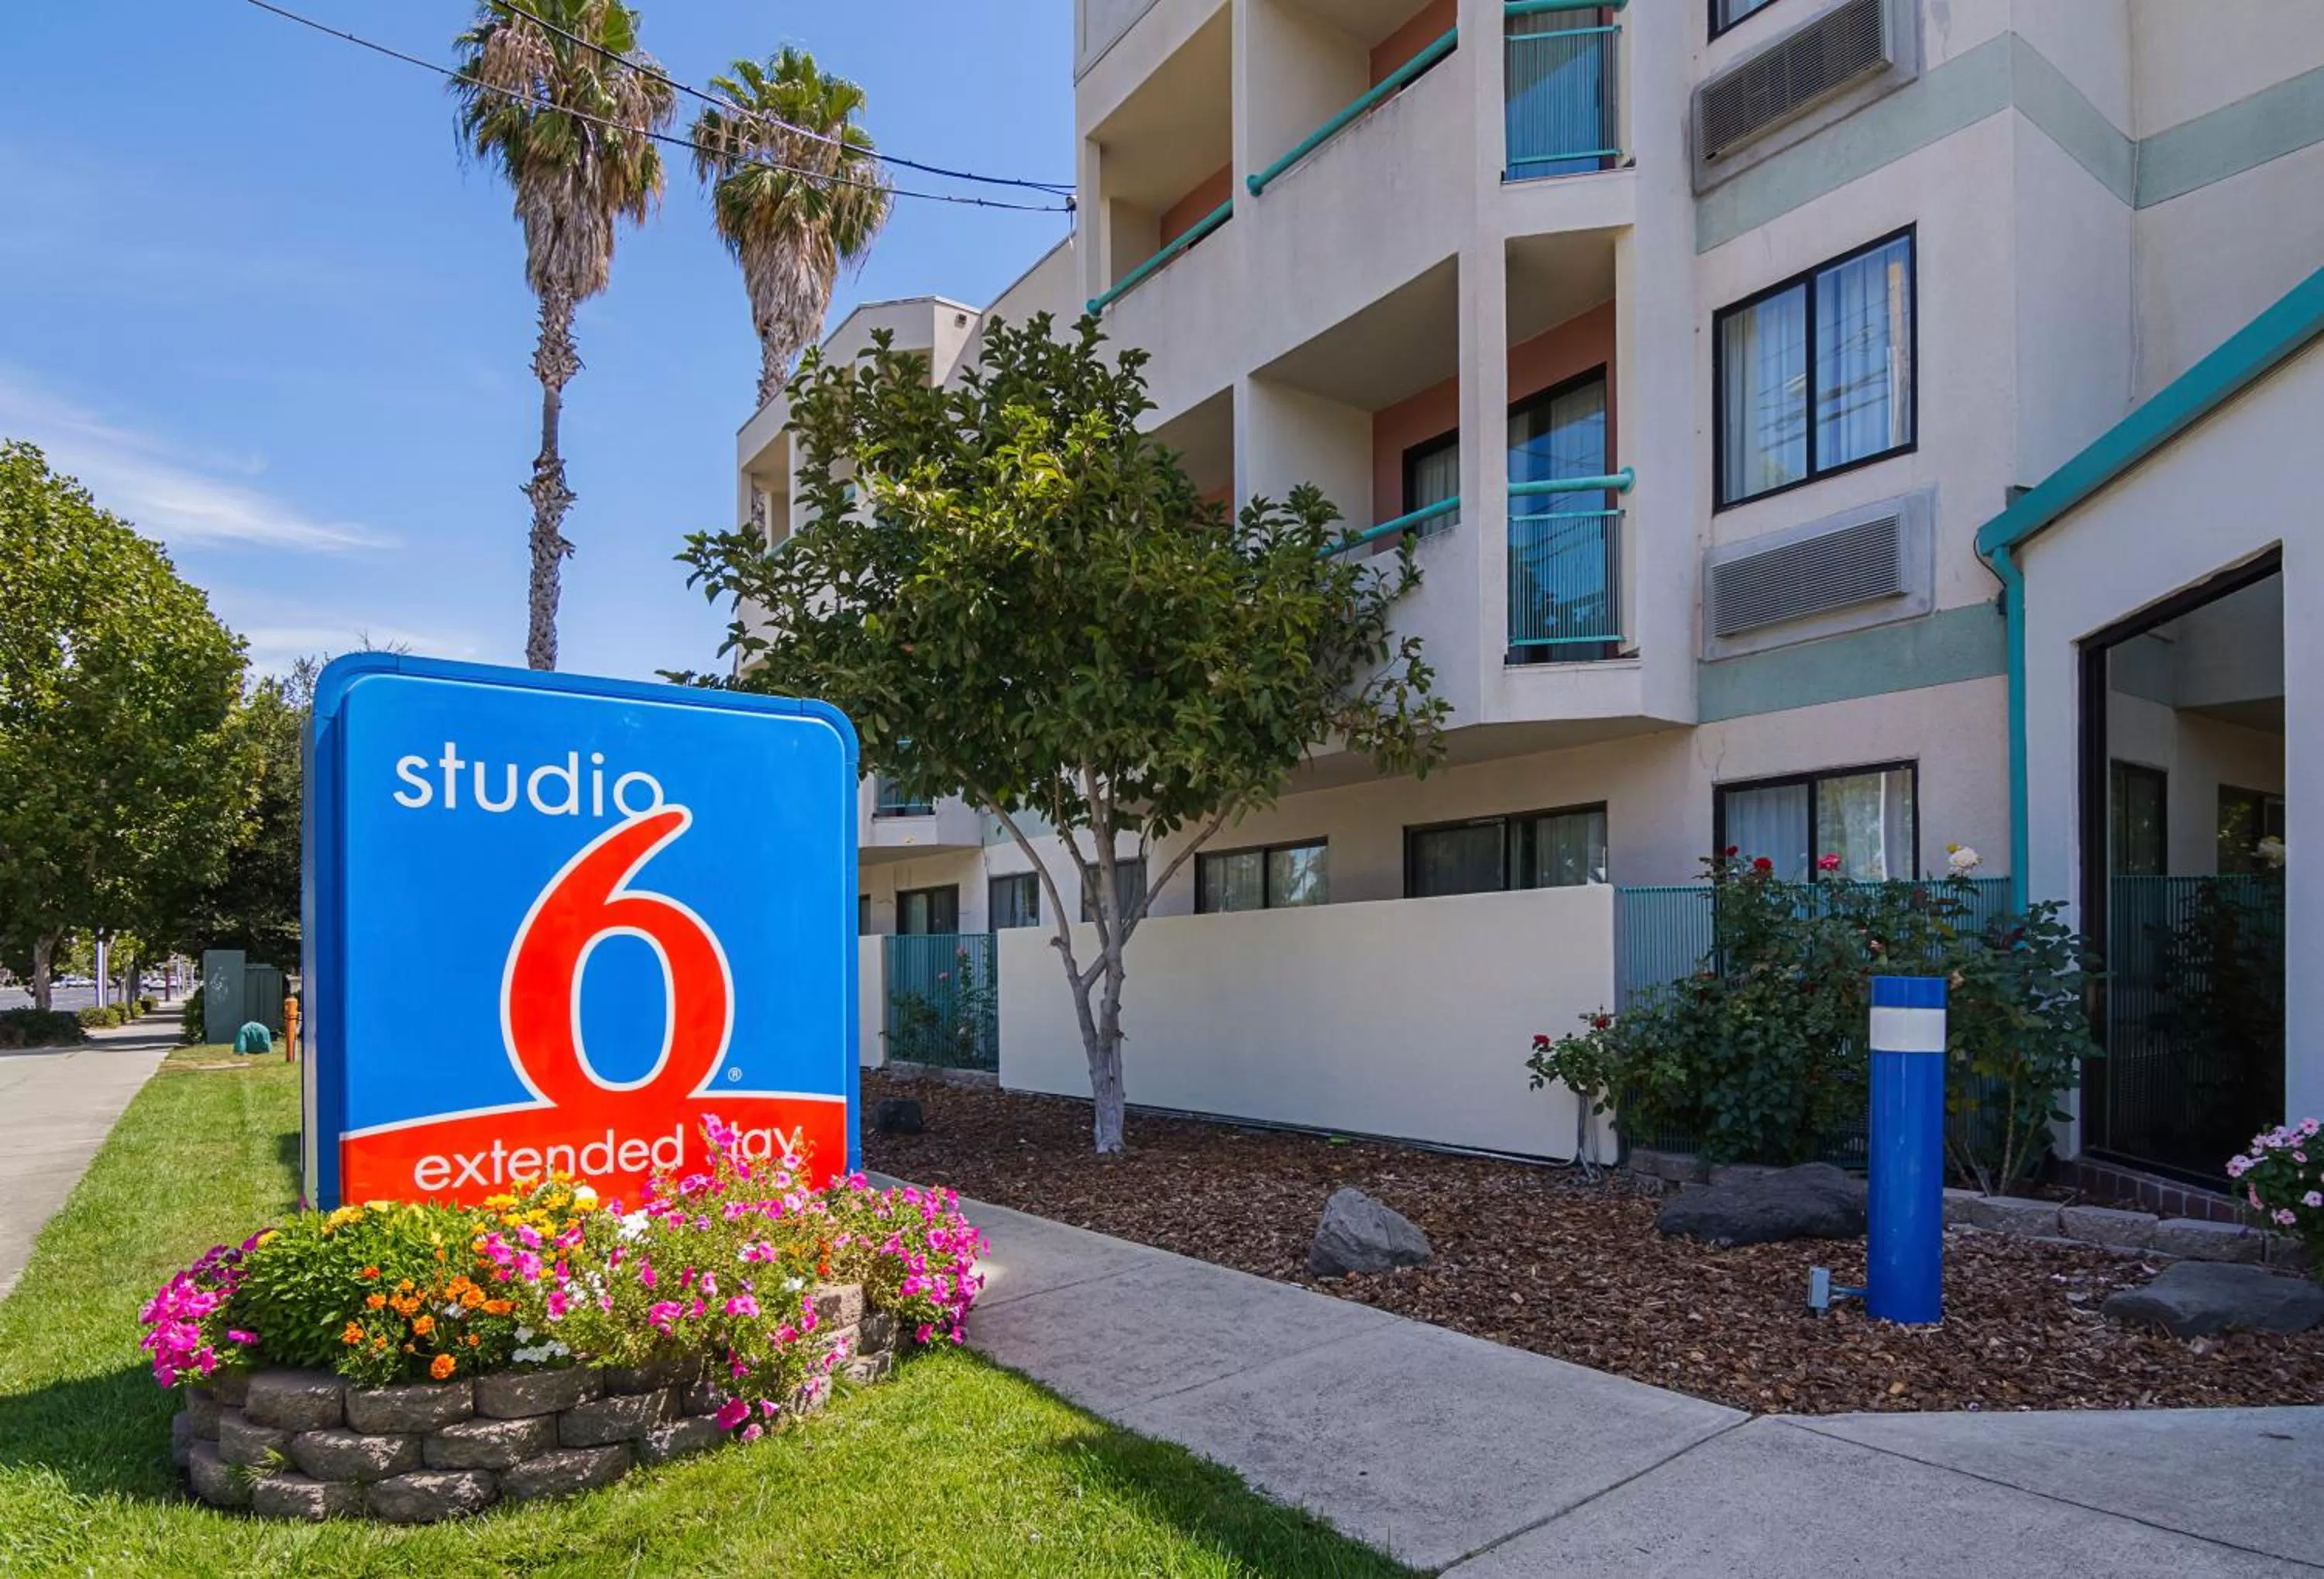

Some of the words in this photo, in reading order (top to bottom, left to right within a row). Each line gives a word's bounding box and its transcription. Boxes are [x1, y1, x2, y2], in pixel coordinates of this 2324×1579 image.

[392, 741, 665, 820] studio
[500, 803, 735, 1108] 6
[414, 1123, 685, 1192] extended
[708, 1121, 803, 1168] tay
